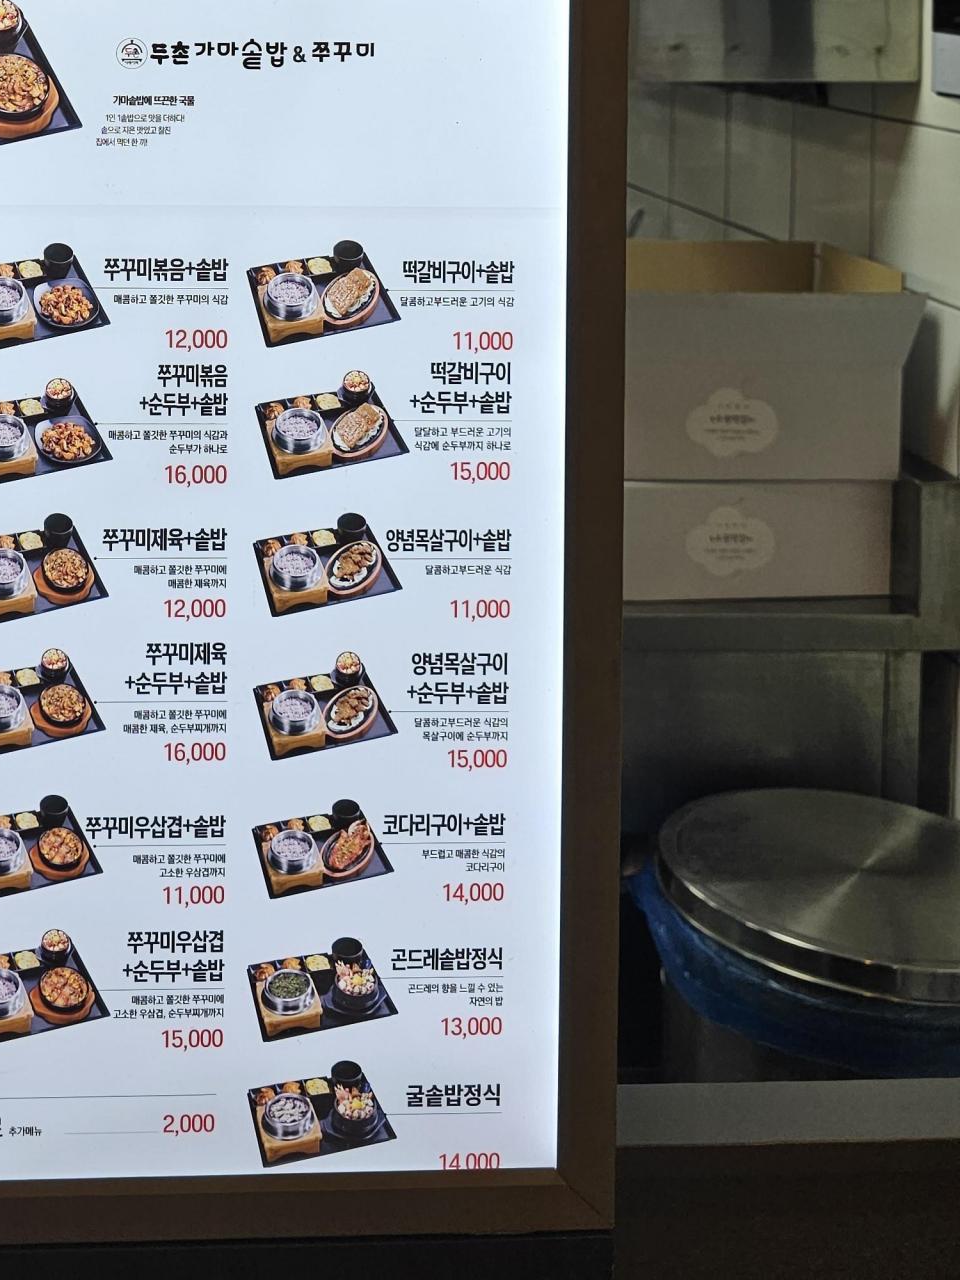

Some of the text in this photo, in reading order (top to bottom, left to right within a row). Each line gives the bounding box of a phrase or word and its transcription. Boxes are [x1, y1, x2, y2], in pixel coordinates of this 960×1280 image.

[104, 258, 229, 282] 쭈꾸미볶음+솥밥
[403, 260, 515, 284] 떡갈비구이+솥밥
[114, 294, 228, 305] 매콤하고 쫄깃한 쭈꾸미의 식감
[165, 329, 227, 352] 12,000
[453, 331, 513, 354] 11,000
[158, 364, 228, 387] 쭈꾸미볶음
[431, 361, 511, 385] 떡갈비구이
[139, 393, 228, 416] +순두부+솥밥
[409, 391, 512, 414] +순두부+솥밥
[169, 445, 228, 454] 순두부가 하나로
[164, 464, 227, 487] 16,000
[450, 461, 510, 484] 15,000
[103, 528, 227, 551] 쭈꾸미제육+솥밥
[386, 529, 511, 552] 양념목살구이+솥밥
[164, 599, 226, 621] 12,000
[450, 599, 510, 622] 11,000
[146, 642, 227, 666] 쭈꾸미제육
[412, 652, 508, 676] 양념목살구이
[125, 672, 227, 695] +순두부+솥밥
[407, 682, 509, 704] +순두부+솥밥
[164, 742, 226, 765] 16,000
[447, 749, 507, 771] 15,000
[382, 813, 506, 836] 코다리구이+솥밥
[465, 862, 505, 872] 코다리구이
[162, 885, 225, 908] 11,000
[442, 882, 504, 905] 14,000
[391, 948, 503, 970] 곤드레솥밥정식
[122, 959, 225, 983] +순두부+솥밥
[408, 983, 504, 993] 곤드레의 향을 느낄 수 있는
[469, 996, 503, 1006] 자연의 밥
[441, 1016, 502, 1039] 13,000
[161, 1029, 223, 1051] 15,000
[406, 1083, 500, 1107] 굴솥밥정식
[8, 1127, 42, 1136] 추가메뉴
[163, 1113, 215, 1136] 2,000
